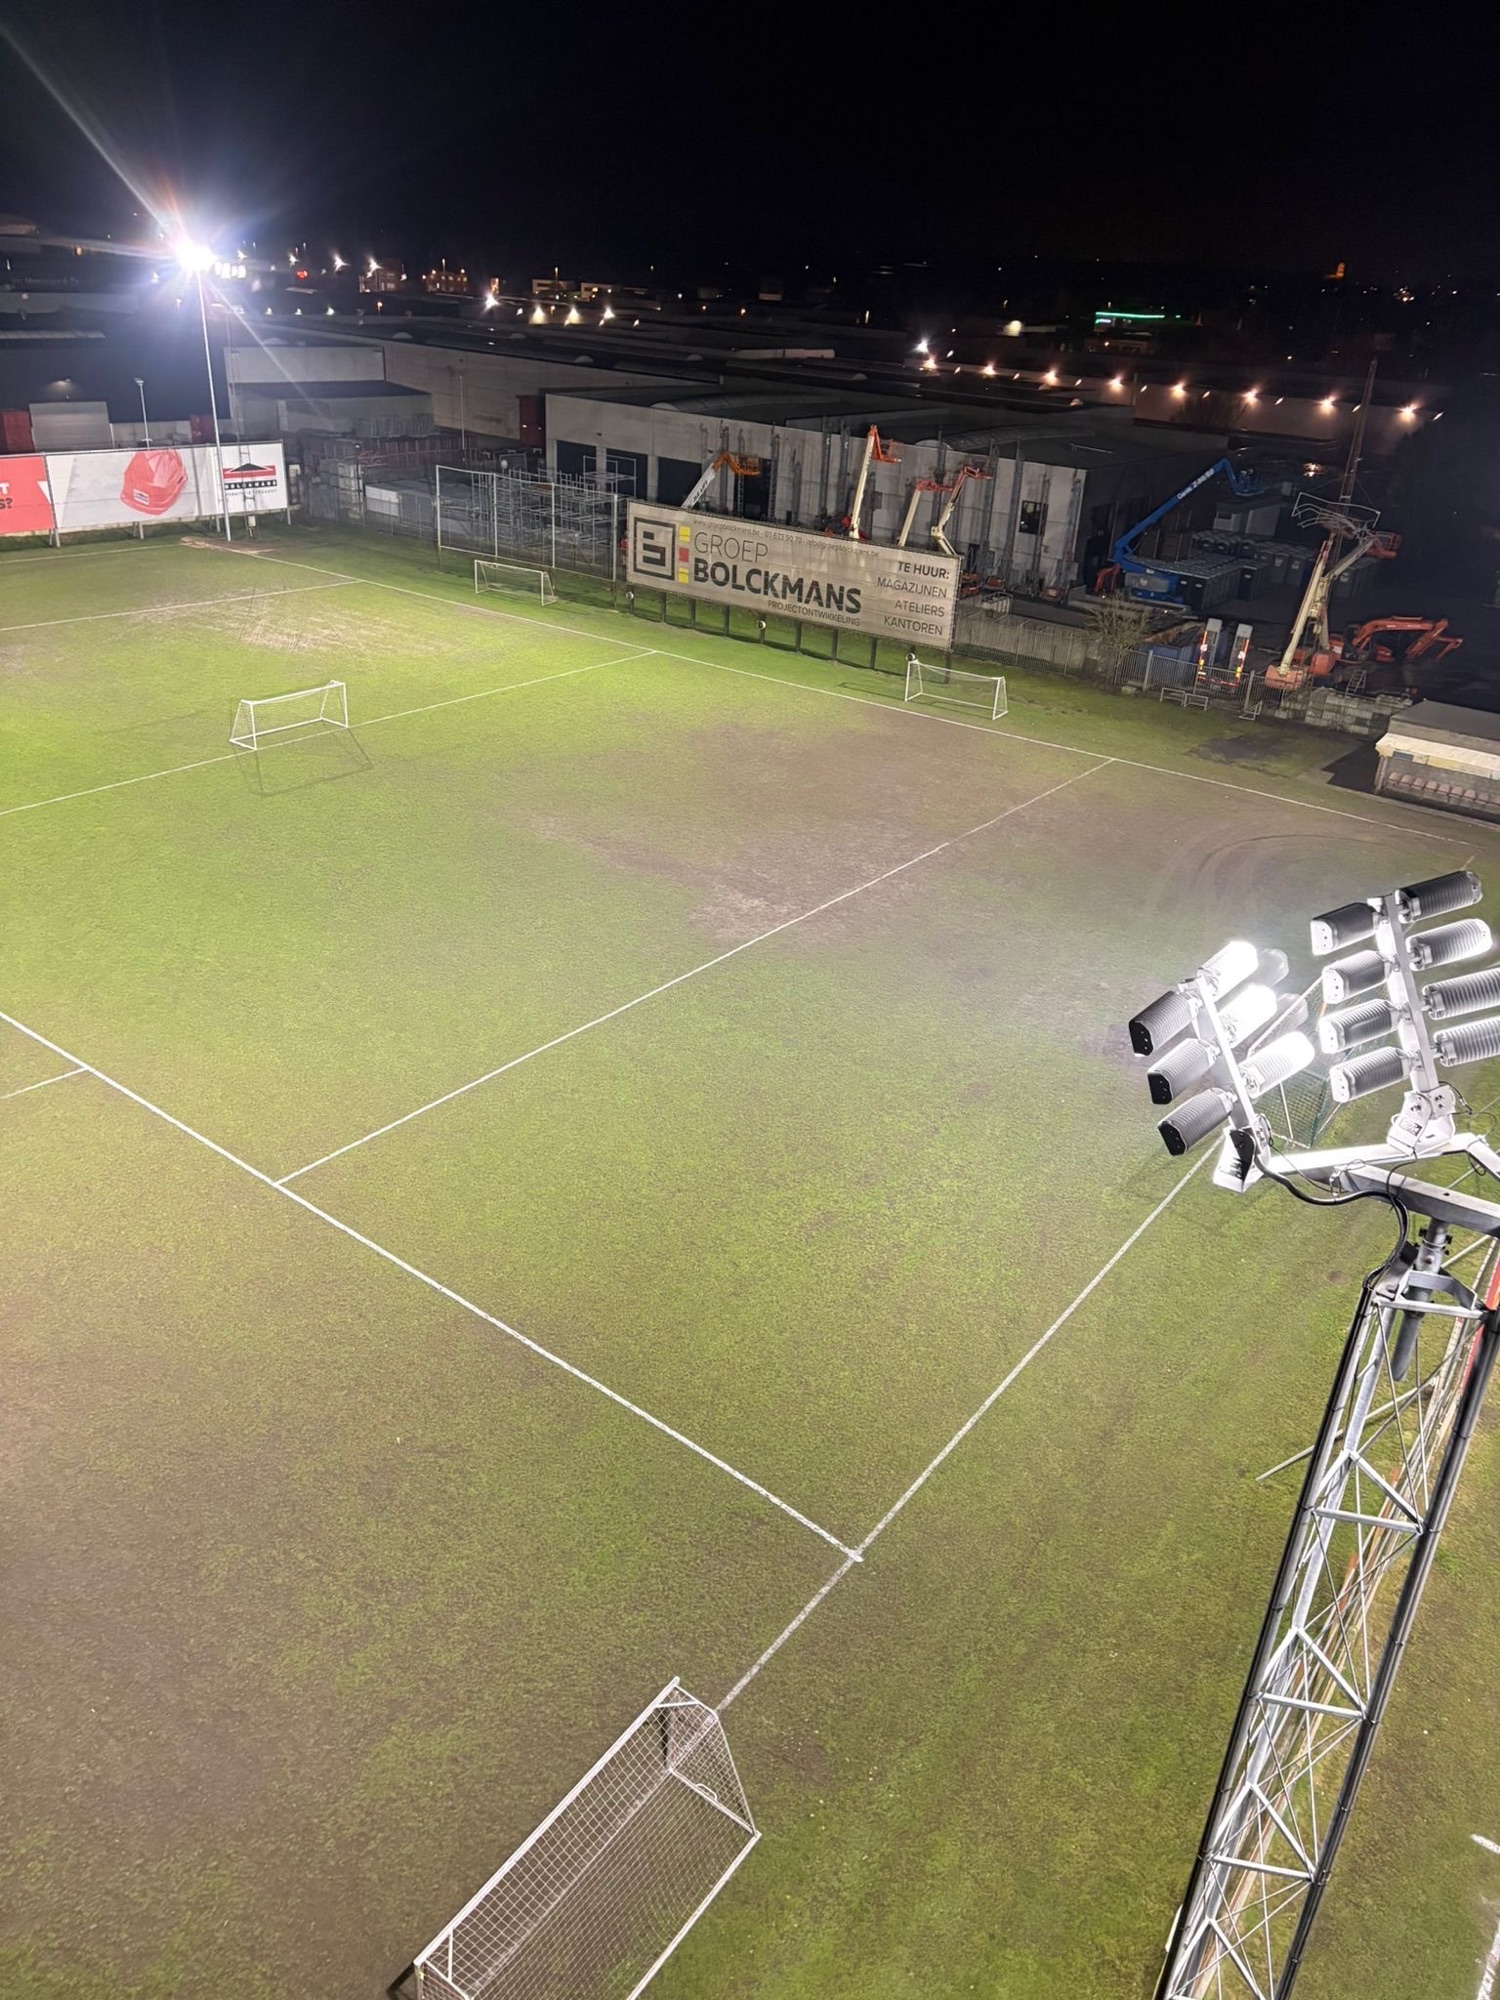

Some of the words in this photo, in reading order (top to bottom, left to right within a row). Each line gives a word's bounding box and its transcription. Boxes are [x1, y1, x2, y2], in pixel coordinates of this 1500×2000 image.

[694, 531, 768, 563] GROEP
[898, 561, 911, 573] TE
[913, 564, 950, 580] HUUR:
[694, 557, 861, 614] BOLCKMANS
[876, 577, 947, 598] MAGAZIJNEN
[767, 600, 860, 626] PROJECTONTWIKKELING
[894, 599, 945, 617] ATELIERS
[884, 615, 943, 636] KANTOREN
